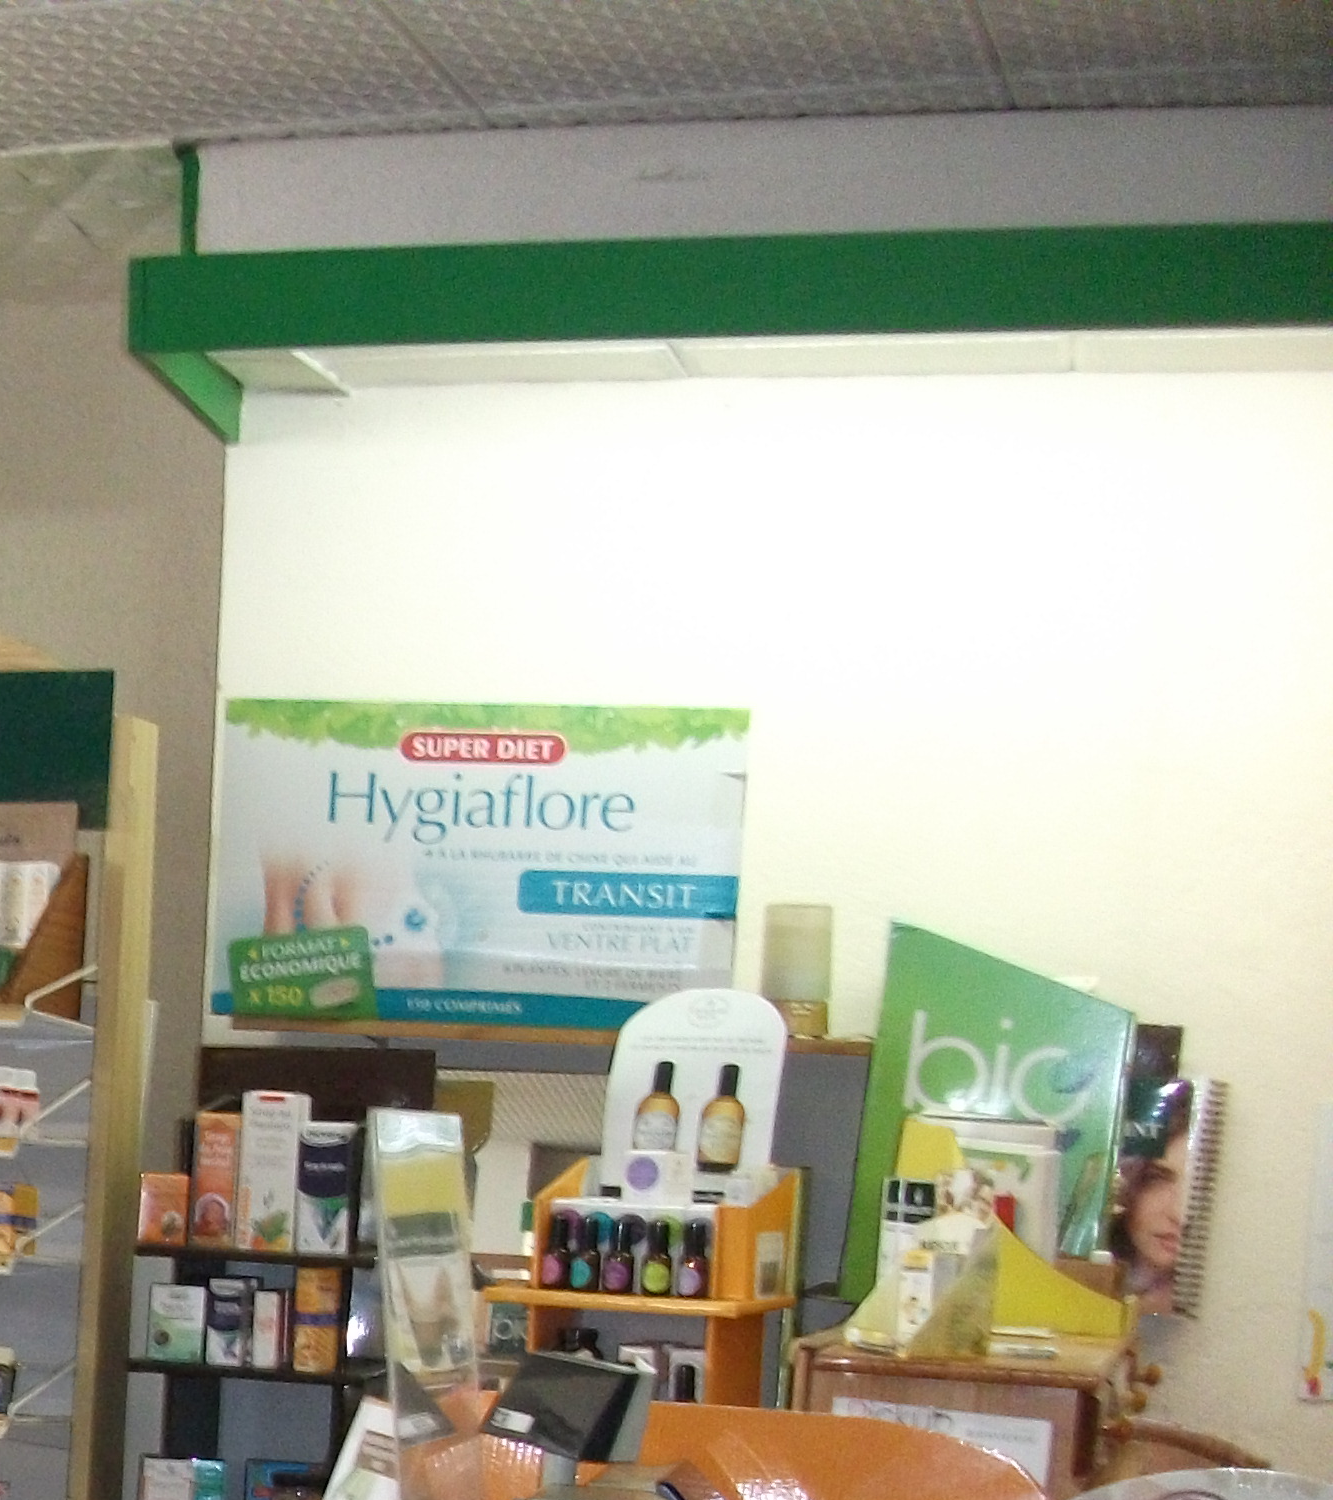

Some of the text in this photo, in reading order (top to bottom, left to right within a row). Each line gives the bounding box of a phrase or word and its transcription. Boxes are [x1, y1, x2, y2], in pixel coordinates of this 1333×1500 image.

[411, 734, 555, 761] SUPER DIET
[326, 769, 636, 845] Hygiaflore
[552, 880, 697, 910] TRANSIT
